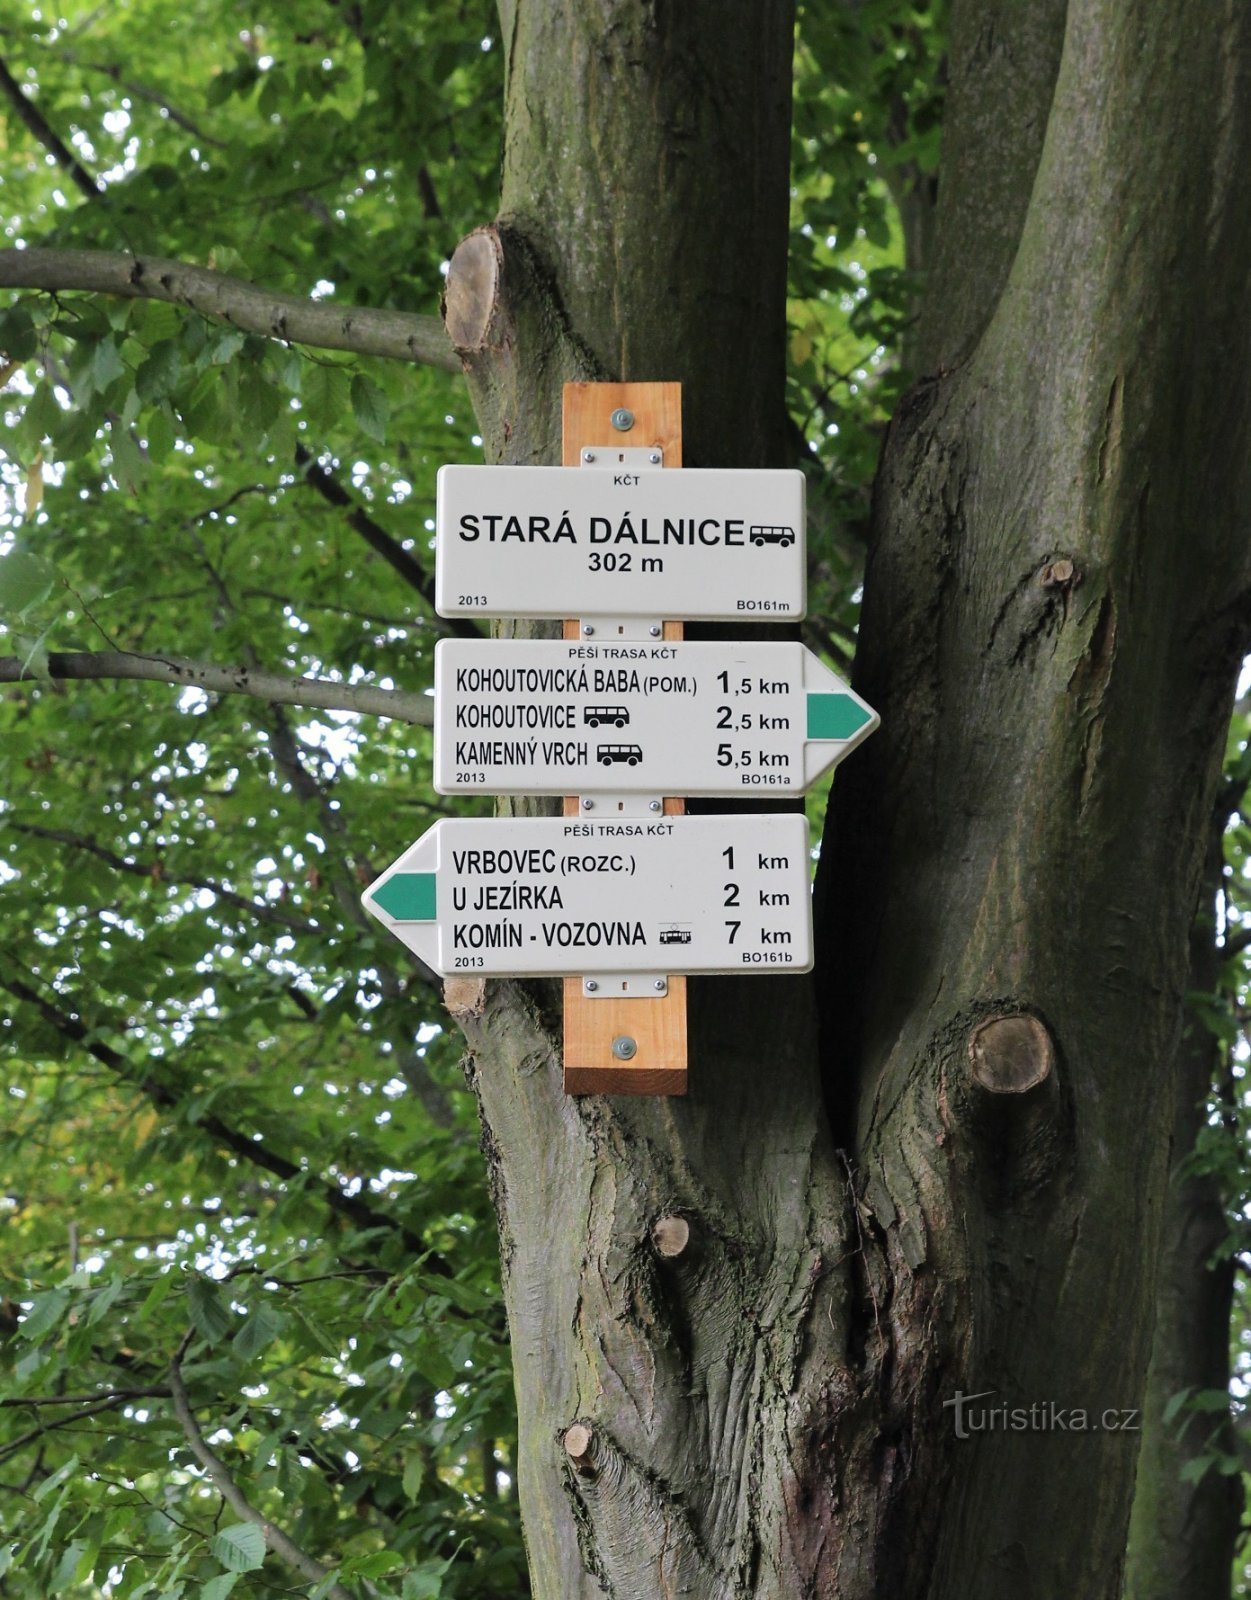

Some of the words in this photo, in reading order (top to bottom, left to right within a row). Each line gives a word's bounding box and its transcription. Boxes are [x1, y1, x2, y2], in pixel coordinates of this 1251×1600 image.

[613, 473, 641, 486] KČT
[458, 509, 578, 545] STARÁ
[589, 510, 745, 547] DÁLNICE
[588, 552, 632, 573] 302
[641, 557, 664, 573] m
[458, 595, 488, 606] 2013
[568, 646, 599, 659] PĚŠÍ
[603, 647, 648, 660] TRASA
[651, 646, 678, 660] KČT
[456, 666, 590, 693] KOHOUTOVICKÁ
[594, 669, 641, 693] BABA
[643, 676, 697, 697] (POM.)
[716, 670, 752, 697] 1,5
[759, 677, 790, 695] km
[456, 704, 576, 729] KOHOUTOVICE
[716, 706, 752, 733] 2,5
[759, 713, 790, 730] km
[455, 737, 538, 766] KAMENNÝ
[541, 741, 588, 766] VRCH
[716, 743, 752, 769] 5,5
[759, 750, 790, 767] km
[456, 772, 486, 783] 2013
[563, 823, 594, 837] PĚŠÍ
[597, 824, 642, 838] TRASA
[646, 822, 674, 836] KČT
[452, 848, 556, 875] VRBOVEC
[560, 854, 636, 877] (ROZC.)
[722, 845, 735, 870] 1
[758, 852, 789, 870] km
[452, 886, 467, 911] U
[473, 879, 564, 911] JEZÍRKA
[723, 882, 741, 908] 2
[759, 889, 790, 907] km
[453, 917, 523, 949] KOMÍN
[541, 921, 647, 947] VOZOVNA
[724, 920, 742, 945] 7
[760, 927, 792, 945] km
[454, 956, 484, 968] 2013
